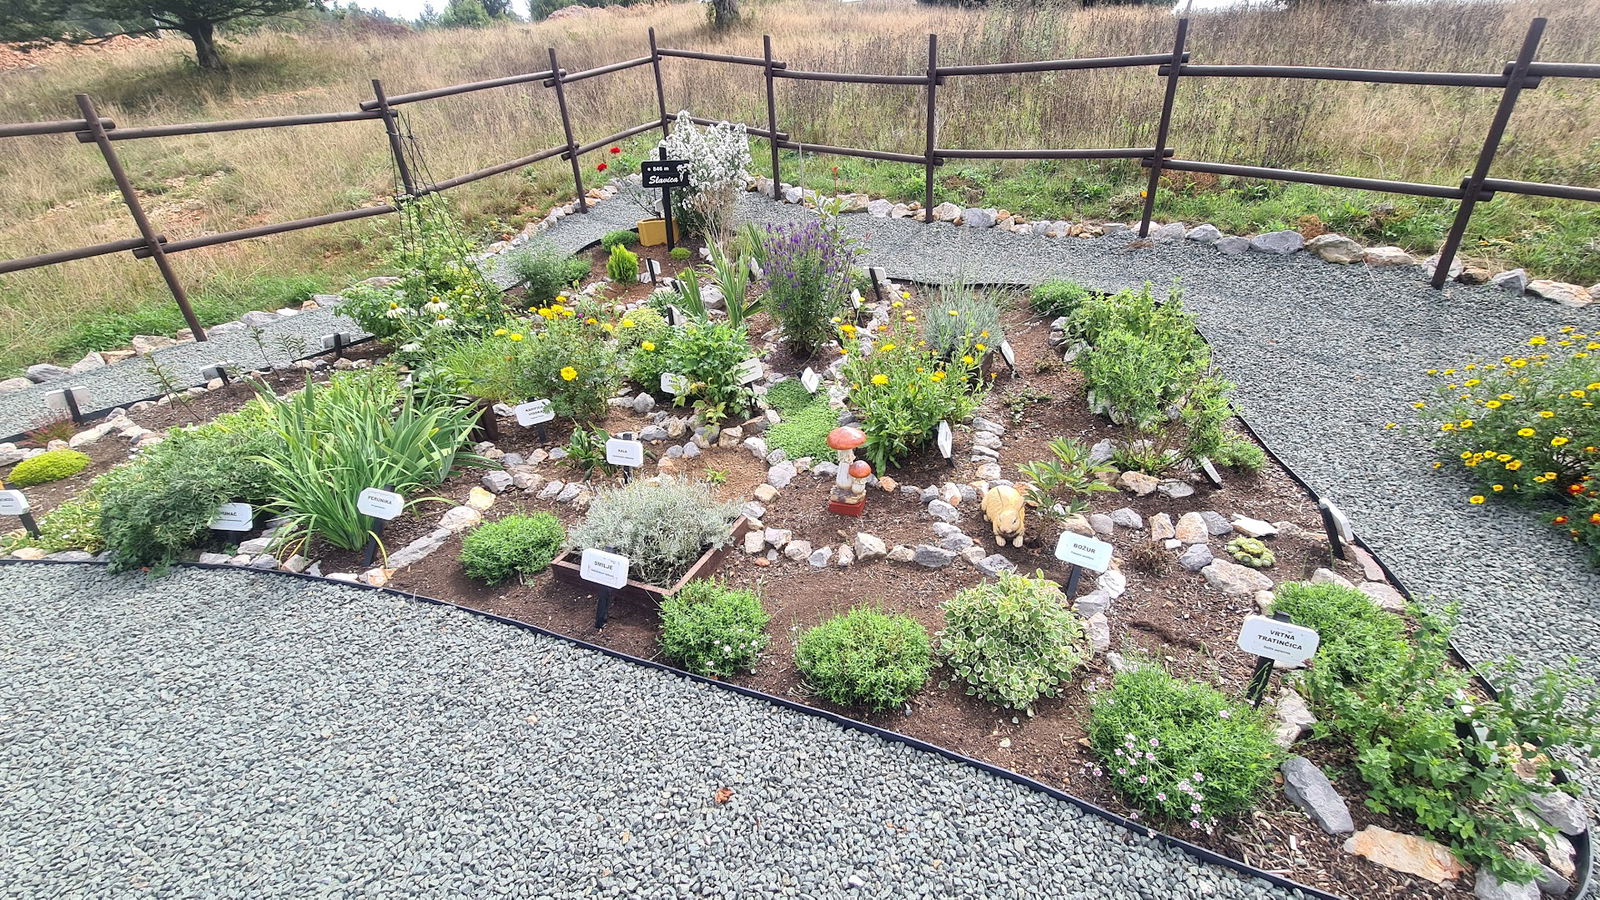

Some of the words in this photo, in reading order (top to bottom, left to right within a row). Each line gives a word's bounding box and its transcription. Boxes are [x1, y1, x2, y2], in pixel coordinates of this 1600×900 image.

[648, 175, 679, 185] Slavica
[368, 495, 392, 505] PERUNIKA
[1073, 543, 1096, 554] BOŽUR
[594, 560, 613, 570] SMILJE
[1269, 630, 1295, 641] VRTNA
[1257, 634, 1303, 651] TRATINČICA
